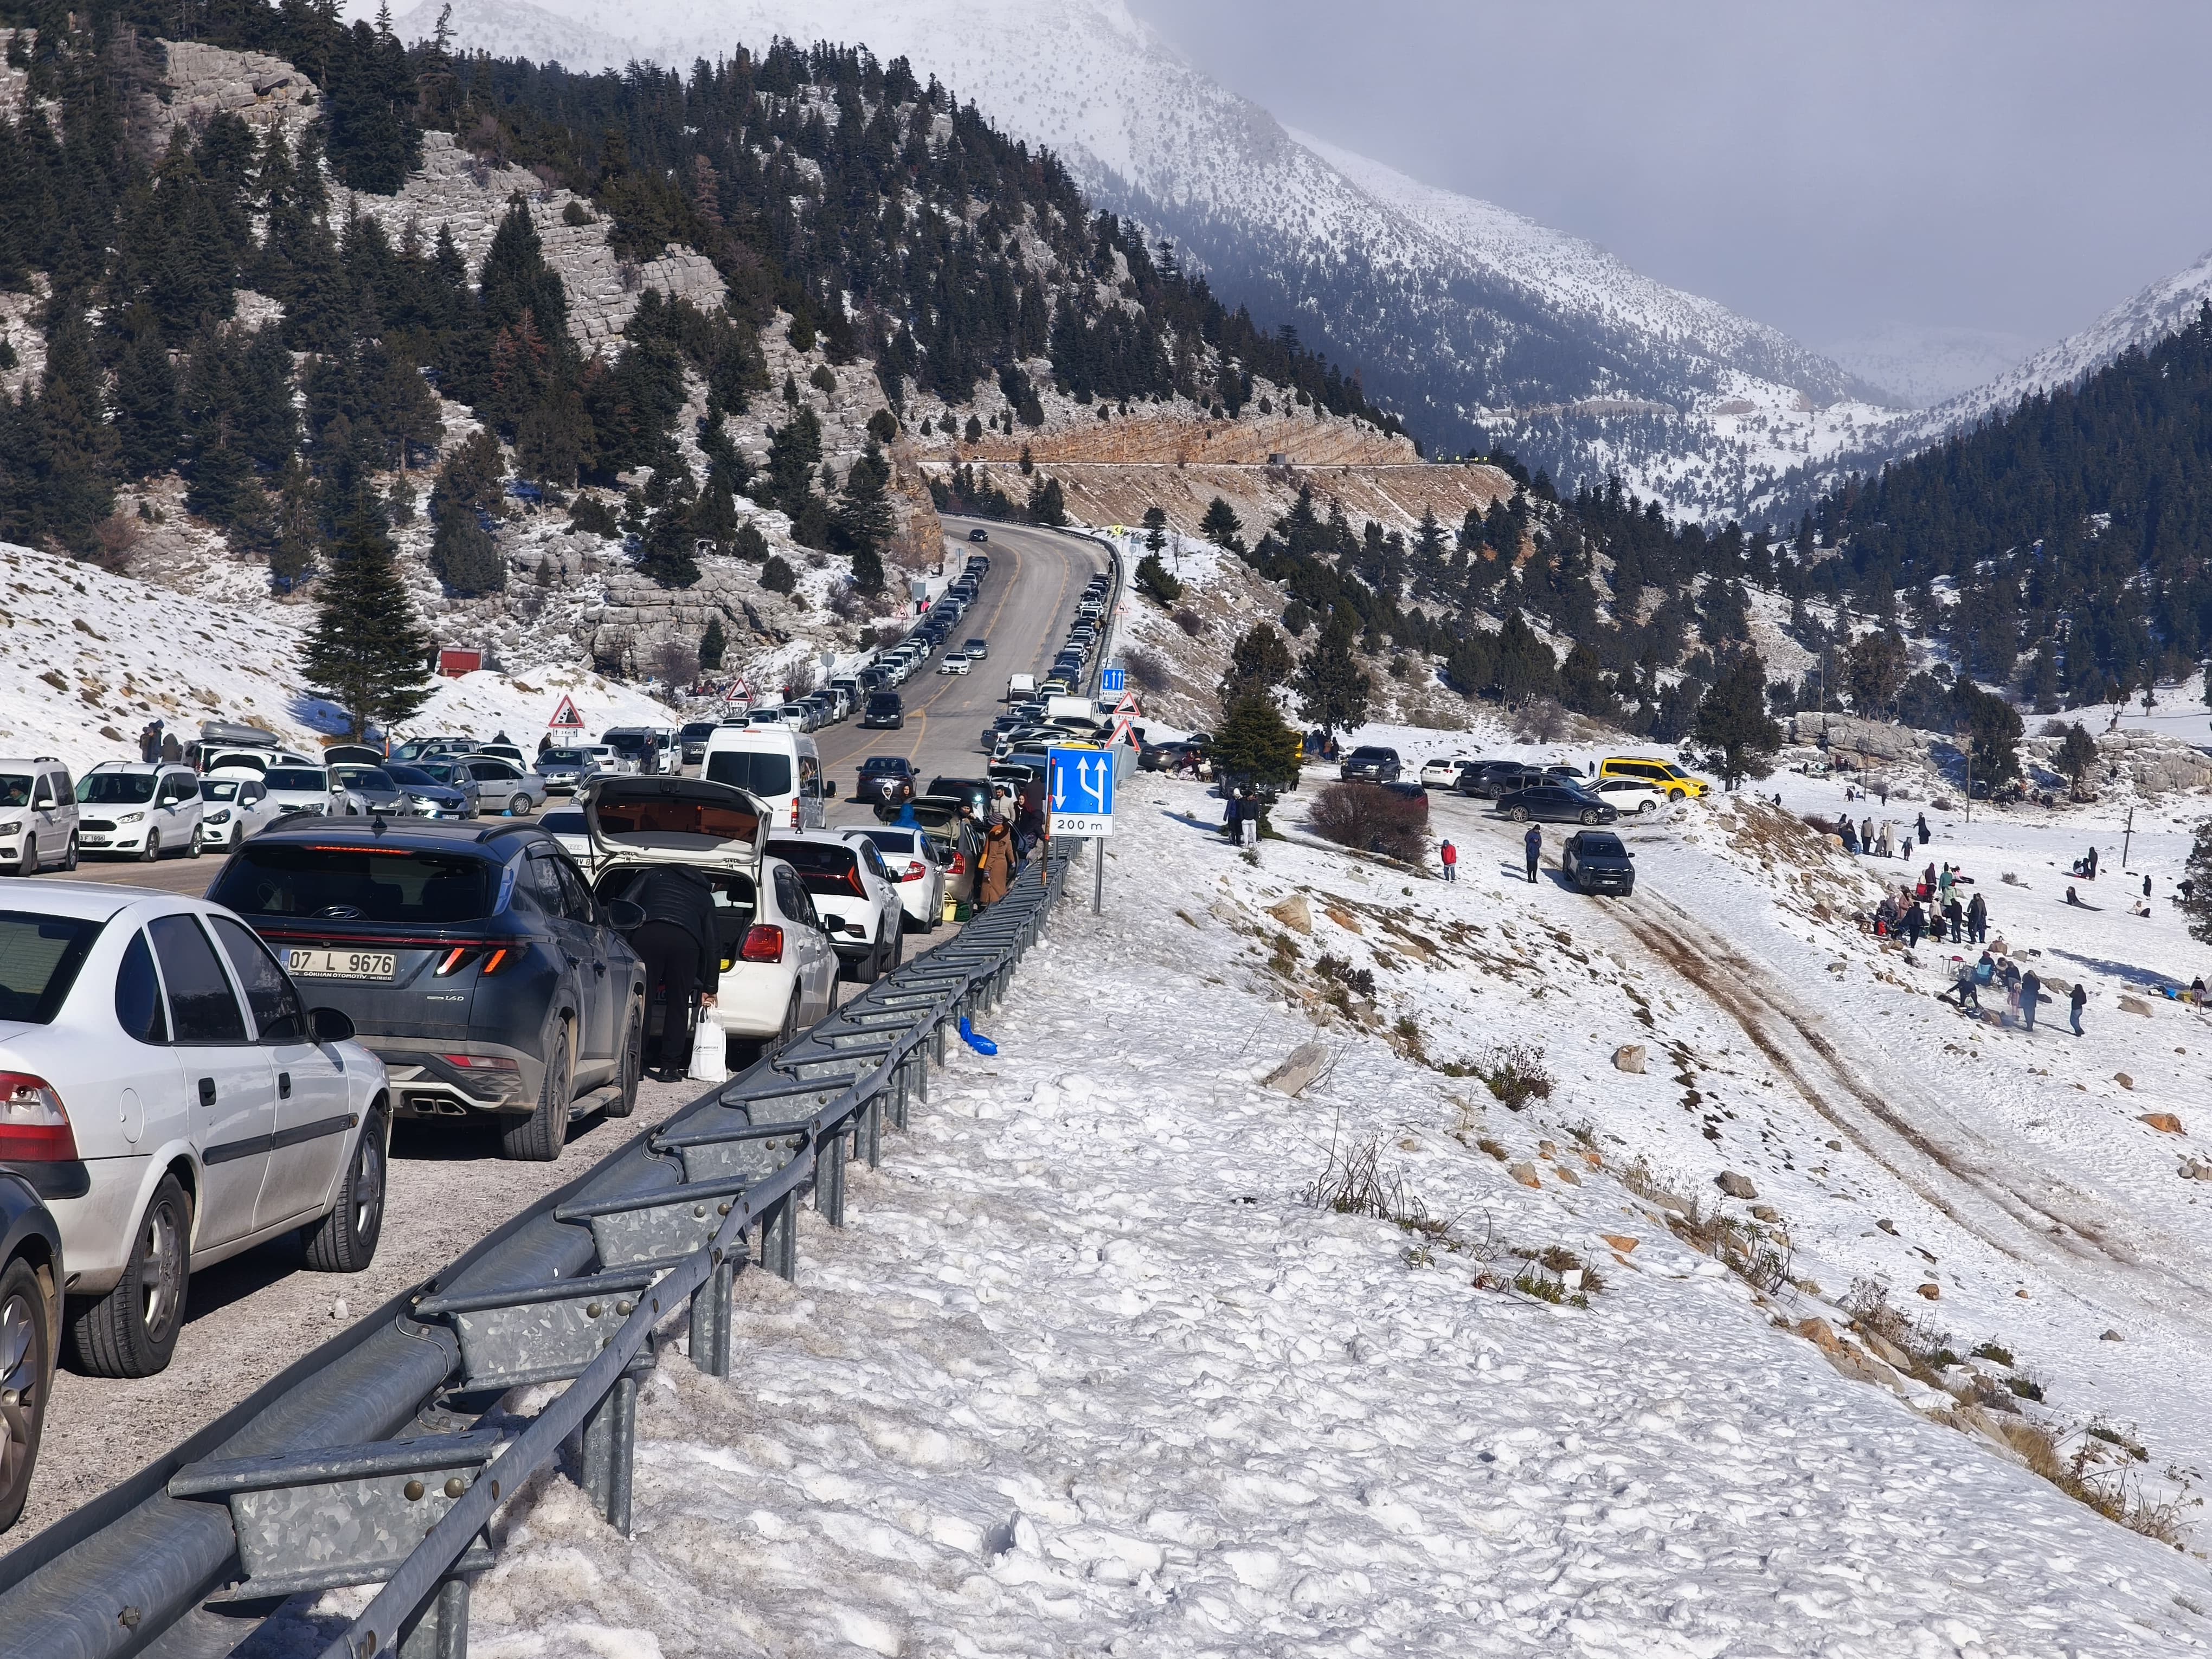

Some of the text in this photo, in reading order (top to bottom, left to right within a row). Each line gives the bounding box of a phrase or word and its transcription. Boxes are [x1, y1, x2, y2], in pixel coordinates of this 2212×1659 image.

[1057, 819, 1085, 829] 200
[290, 951, 393, 973] 07 L 9676
